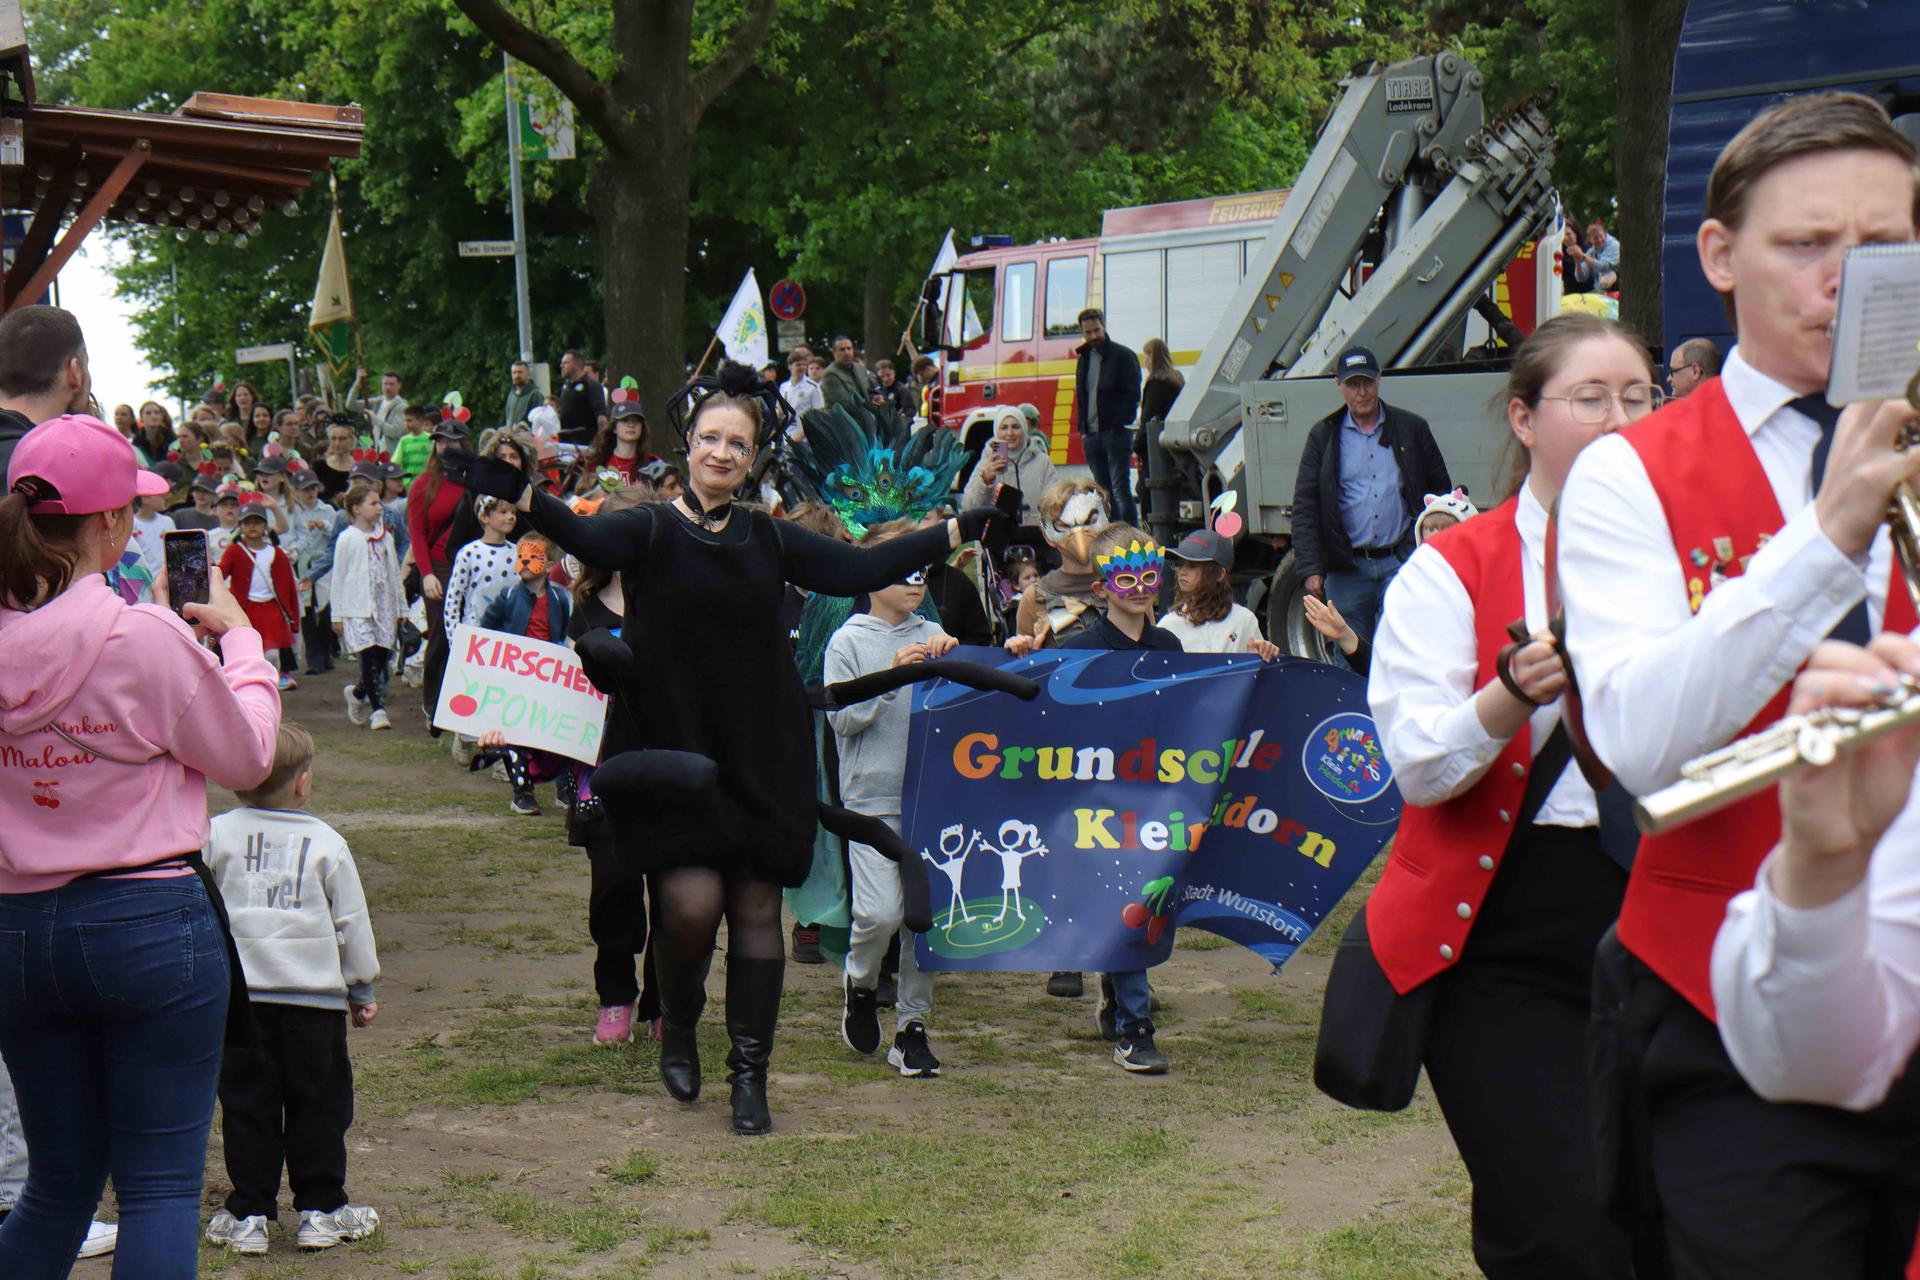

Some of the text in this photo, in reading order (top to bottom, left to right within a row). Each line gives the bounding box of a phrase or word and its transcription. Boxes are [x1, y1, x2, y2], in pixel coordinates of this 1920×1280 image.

[1387, 79, 1430, 98] TIRRE
[1389, 100, 1431, 112] Ladekrane
[476, 684, 600, 750] POWER
[0, 744, 97, 769] Malou
[953, 728, 1283, 785] Grundscle
